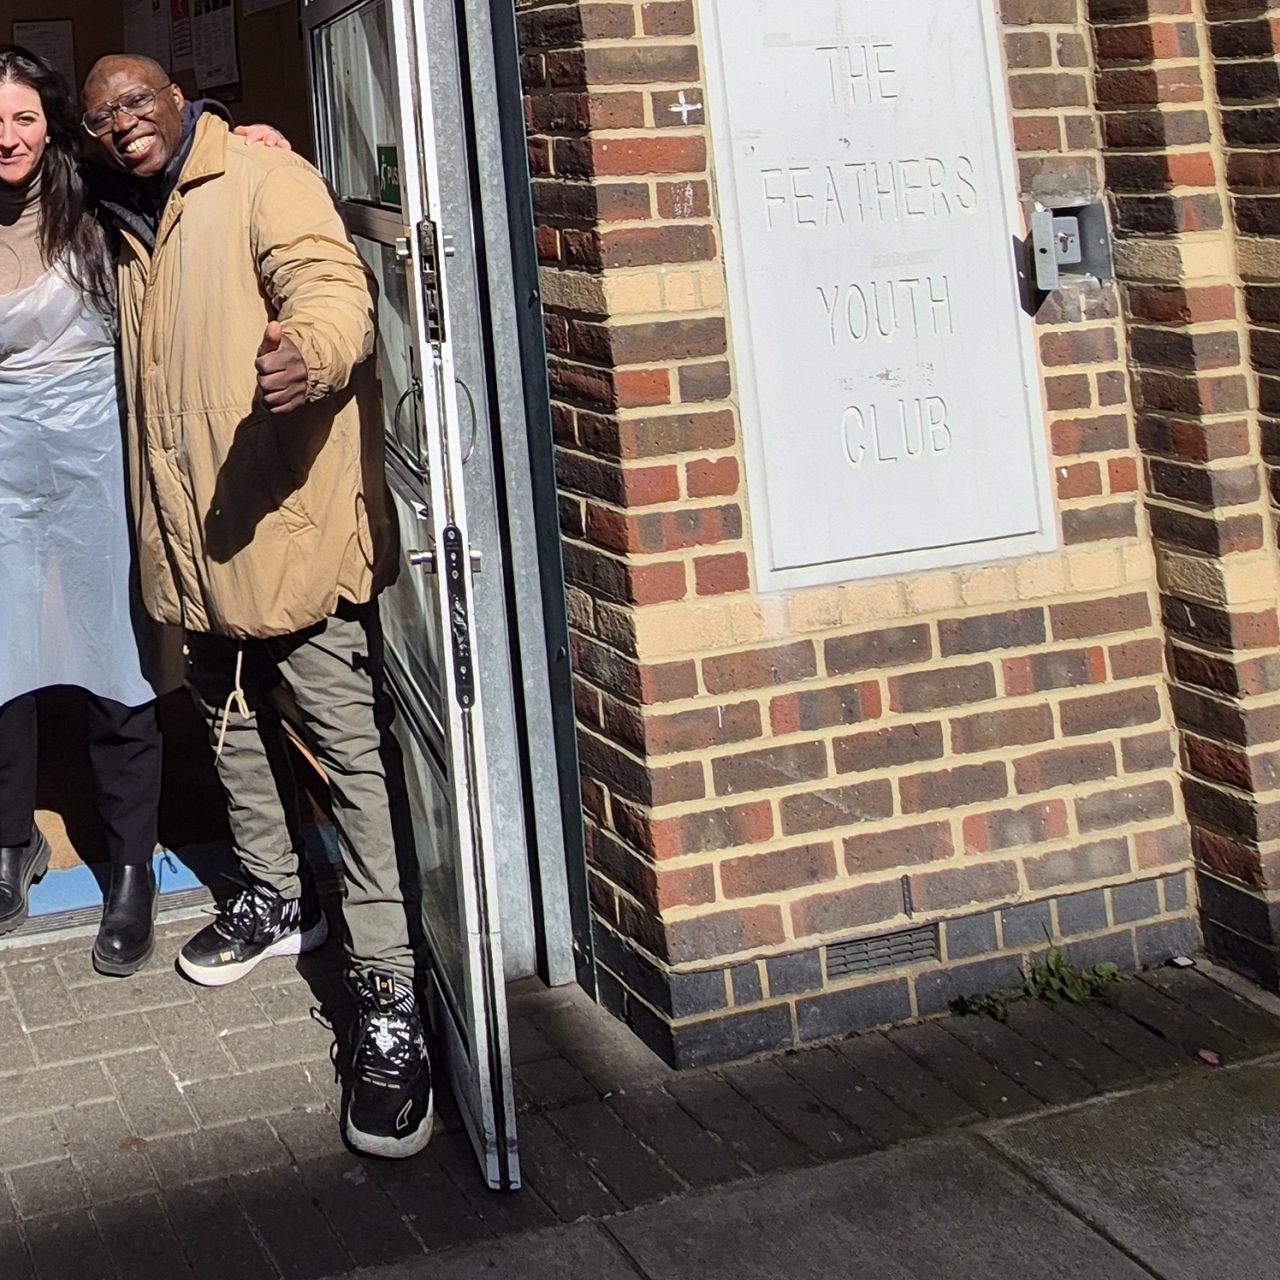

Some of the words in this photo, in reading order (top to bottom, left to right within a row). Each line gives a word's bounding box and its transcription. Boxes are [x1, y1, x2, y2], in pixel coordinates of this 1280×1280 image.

[815, 43, 899, 107] THE
[759, 154, 978, 232] FEATHERS
[816, 273, 955, 347] YOUTH
[839, 395, 953, 468] CLUB
